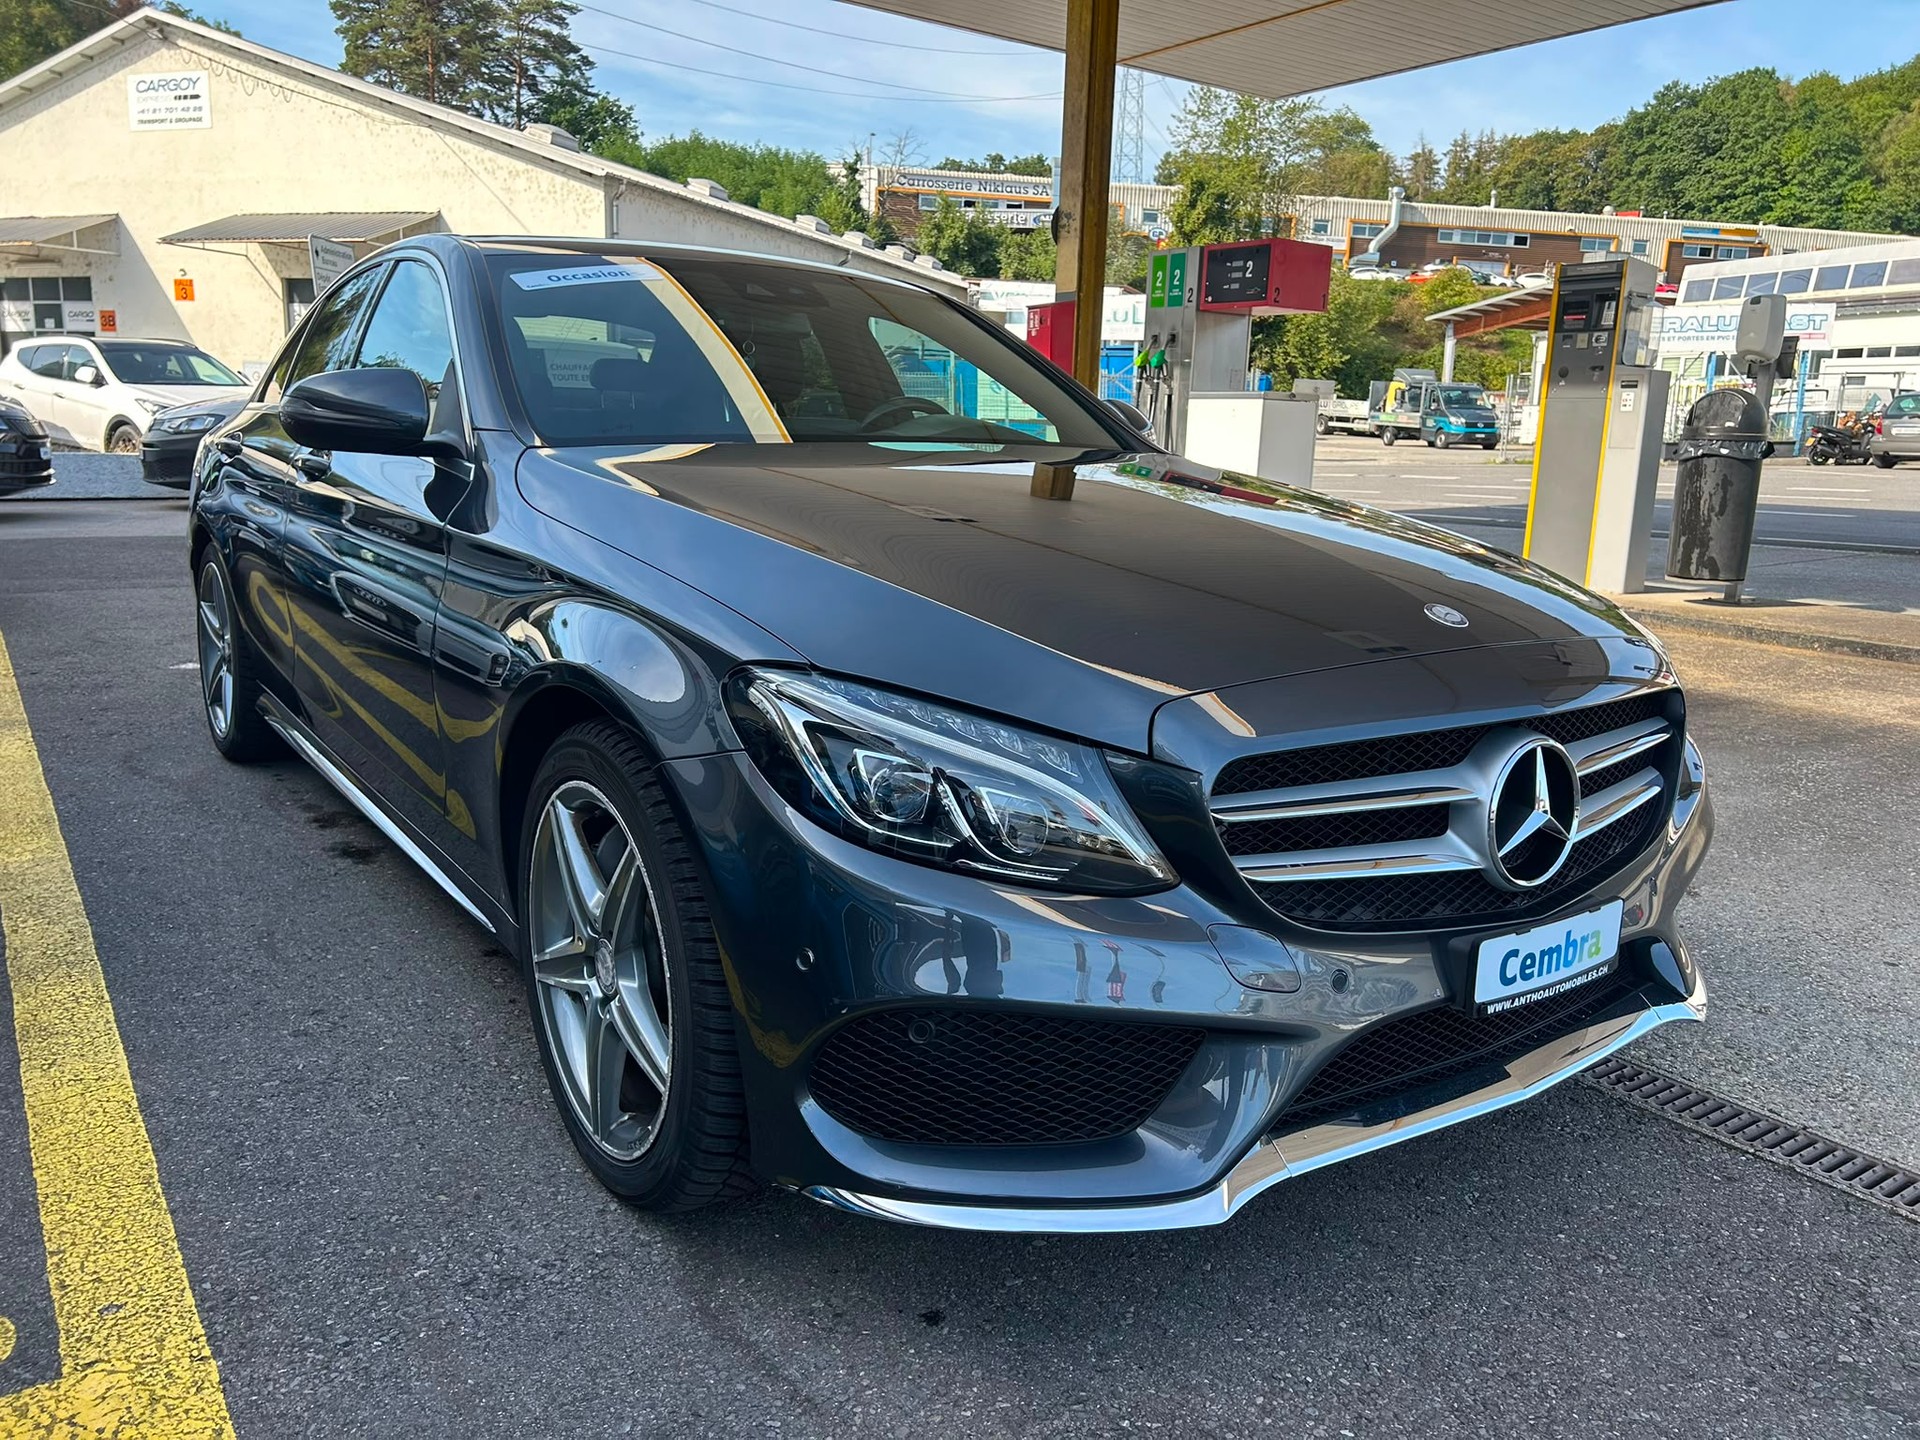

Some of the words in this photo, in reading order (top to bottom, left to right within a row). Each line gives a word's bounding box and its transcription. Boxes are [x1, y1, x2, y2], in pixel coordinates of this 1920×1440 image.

[136, 77, 200, 93] CARGOY
[896, 175, 973, 191] Carrosserie
[977, 181, 1029, 195] Niklaus
[1032, 185, 1050, 196] SA
[547, 270, 631, 282] Occasion
[1173, 269, 1181, 285] 2
[1246, 260, 1254, 278] 2
[1156, 270, 1163, 287] 2
[180, 287, 188, 300] 3
[1187, 287, 1194, 303] 2
[1273, 287, 1281, 304] 2
[100, 315, 116, 327] 3B
[552, 373, 580, 382] TOUTE
[1499, 929, 1602, 987] Cembra
[1487, 964, 1609, 1015] WWW.ANTHOAUTOMOBILES.CH
